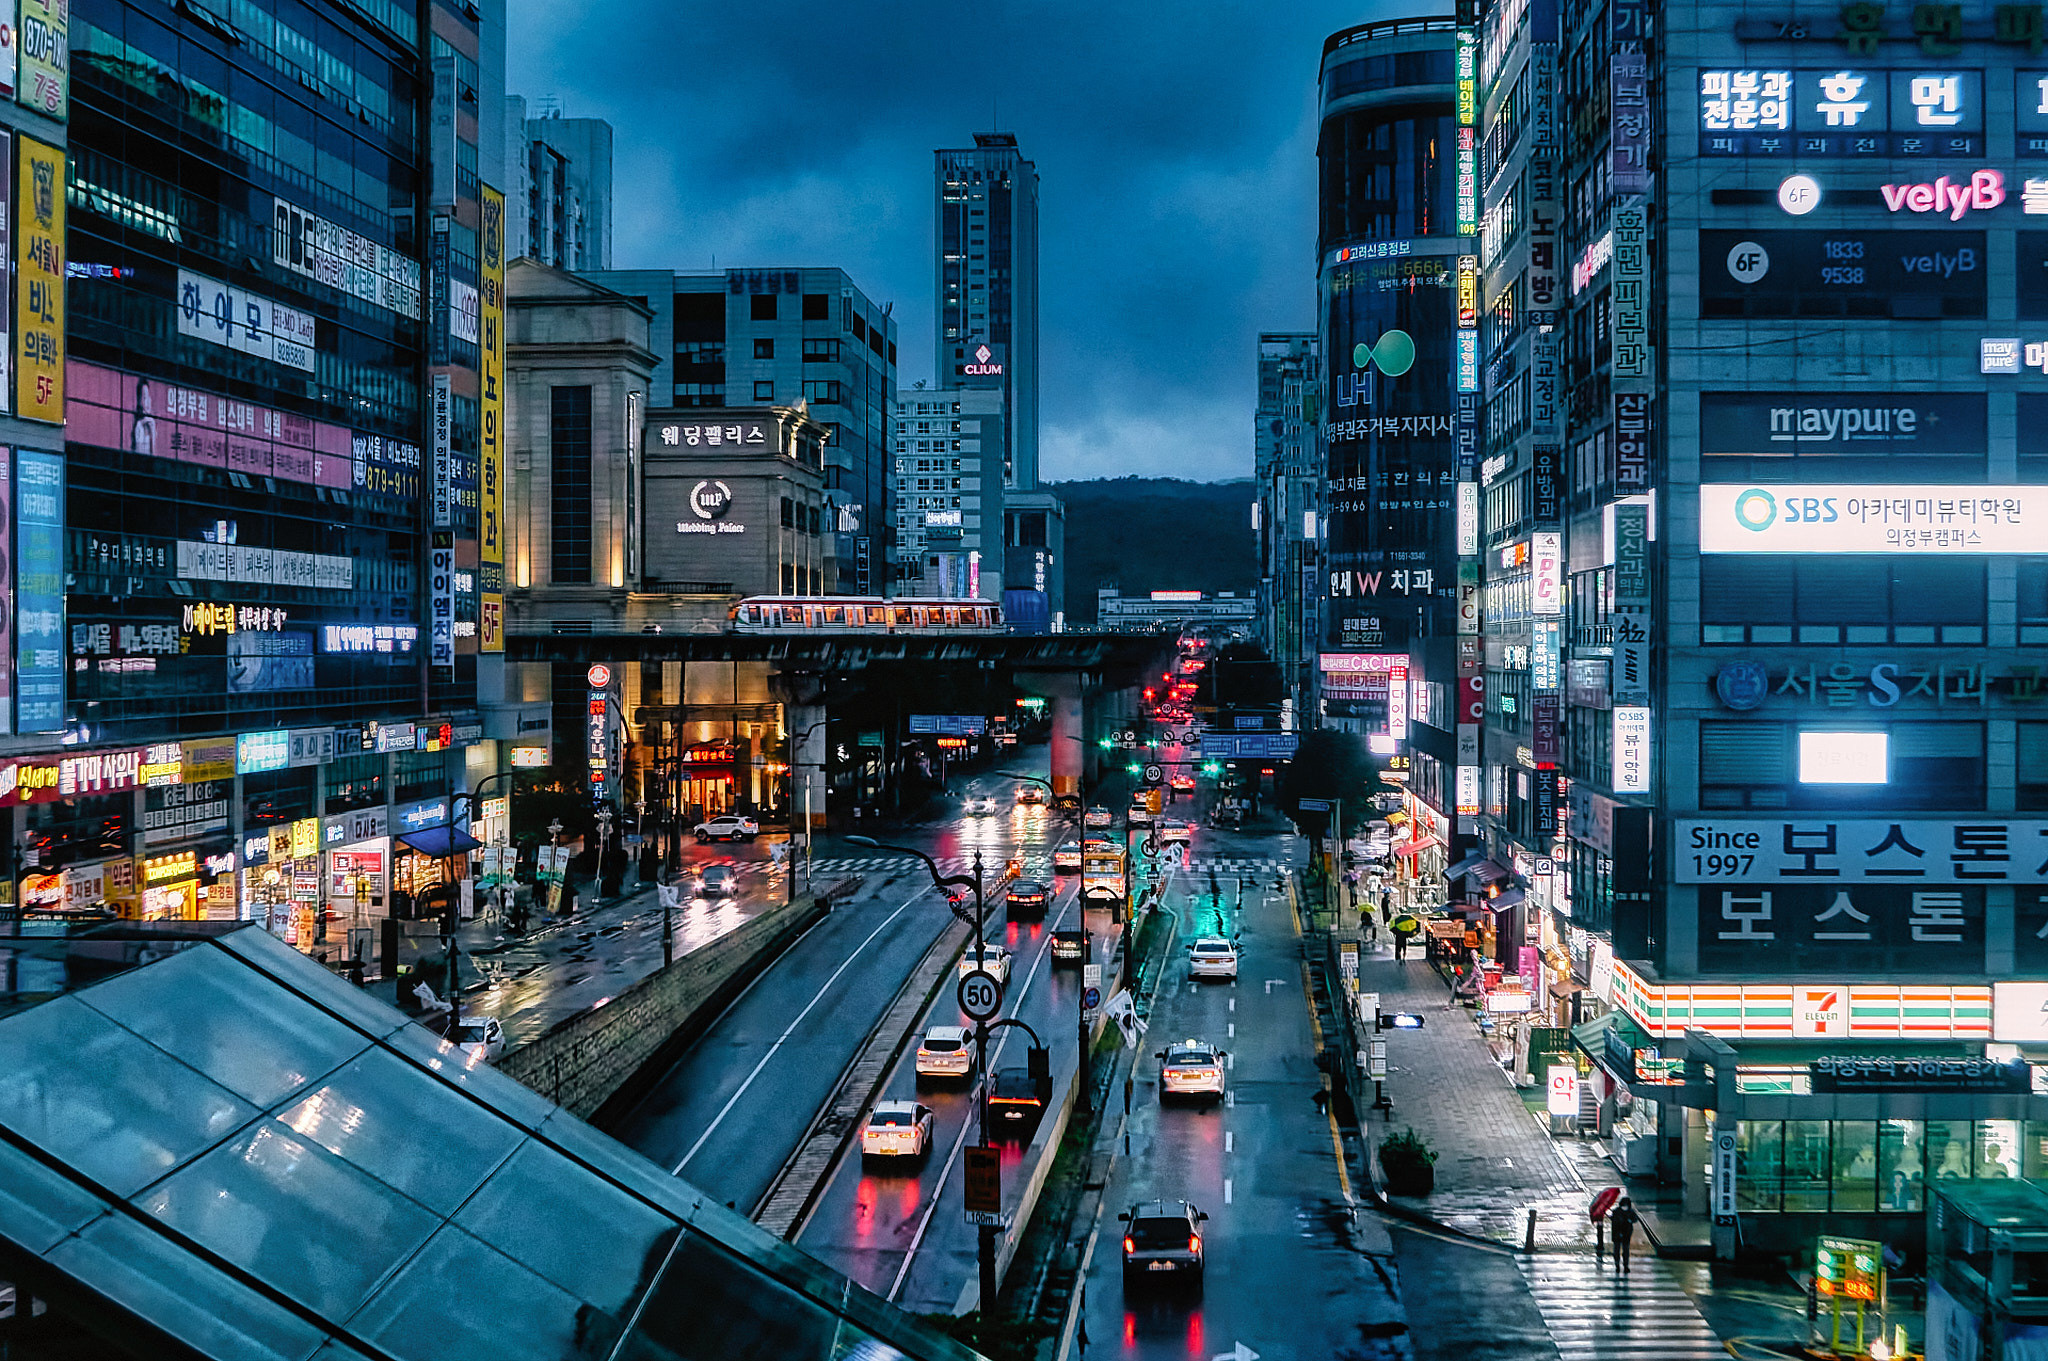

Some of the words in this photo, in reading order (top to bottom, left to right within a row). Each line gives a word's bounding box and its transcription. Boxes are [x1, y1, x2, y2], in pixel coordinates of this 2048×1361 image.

[1614, 65, 1645, 79] 대한
[1702, 71, 1793, 101] 피부과
[1817, 72, 1961, 126] 휴먼
[1616, 84, 1643, 167] 보청기
[1703, 101, 1791, 130] 전문의
[1789, 187, 1809, 203] 6F
[1881, 170, 2004, 221] velyB
[1350, 240, 1411, 260] 고려신용정보
[1736, 254, 1760, 271] 6F
[1824, 242, 1863, 259] 1833
[1902, 249, 1976, 278] velyB
[1822, 268, 1864, 284] 9538
[1616, 211, 1646, 374] 휴먼피부과
[182, 281, 262, 342] 하이모
[964, 365, 1002, 375] CLIUM
[1460, 340, 1475, 390] 정형외과
[1984, 357, 2016, 370] pure
[36, 375, 54, 404] 5F
[1337, 371, 1373, 407] LH
[1535, 361, 1556, 423] 교정과
[661, 426, 765, 446] 웨딩팰리스
[1770, 407, 1916, 441] maypure
[1618, 397, 1647, 486] 산부인과
[367, 466, 418, 499] 879-9111
[1784, 497, 1839, 523] SBS
[1846, 498, 2022, 525] 아카데미뷰티학원
[677, 523, 716, 535] Wedding
[718, 523, 745, 533] Palace
[1886, 529, 1982, 548] 의정부캠퍼스
[1619, 519, 1645, 577] 정신과
[1330, 571, 1351, 596] 연세
[1357, 572, 1383, 595] W
[1390, 570, 1434, 595] 치과
[484, 603, 500, 643] 5F
[1343, 618, 1380, 630] 임대문의
[1461, 642, 1475, 652] kt
[1351, 656, 1380, 670] C&C
[1624, 648, 1638, 682] HAIR
[1391, 689, 1405, 727] 다이소
[1628, 712, 1645, 721] SBS
[590, 715, 606, 758] 사우나
[1539, 710, 1554, 752] 보청기
[102, 751, 141, 788] 사우나
[1148, 769, 1159, 778] 50
[1624, 735, 1640, 787] 뷰티학원
[1690, 827, 1760, 850] Since
[1779, 824, 2010, 880] 보스톤
[1692, 854, 1755, 877] 1997
[1718, 891, 1965, 942] 보스톤
[966, 985, 993, 1006] 50
[1804, 1011, 1839, 1021] ELEVEN
[1552, 1076, 1575, 1102] 약
[971, 1212, 994, 1225] 100m
